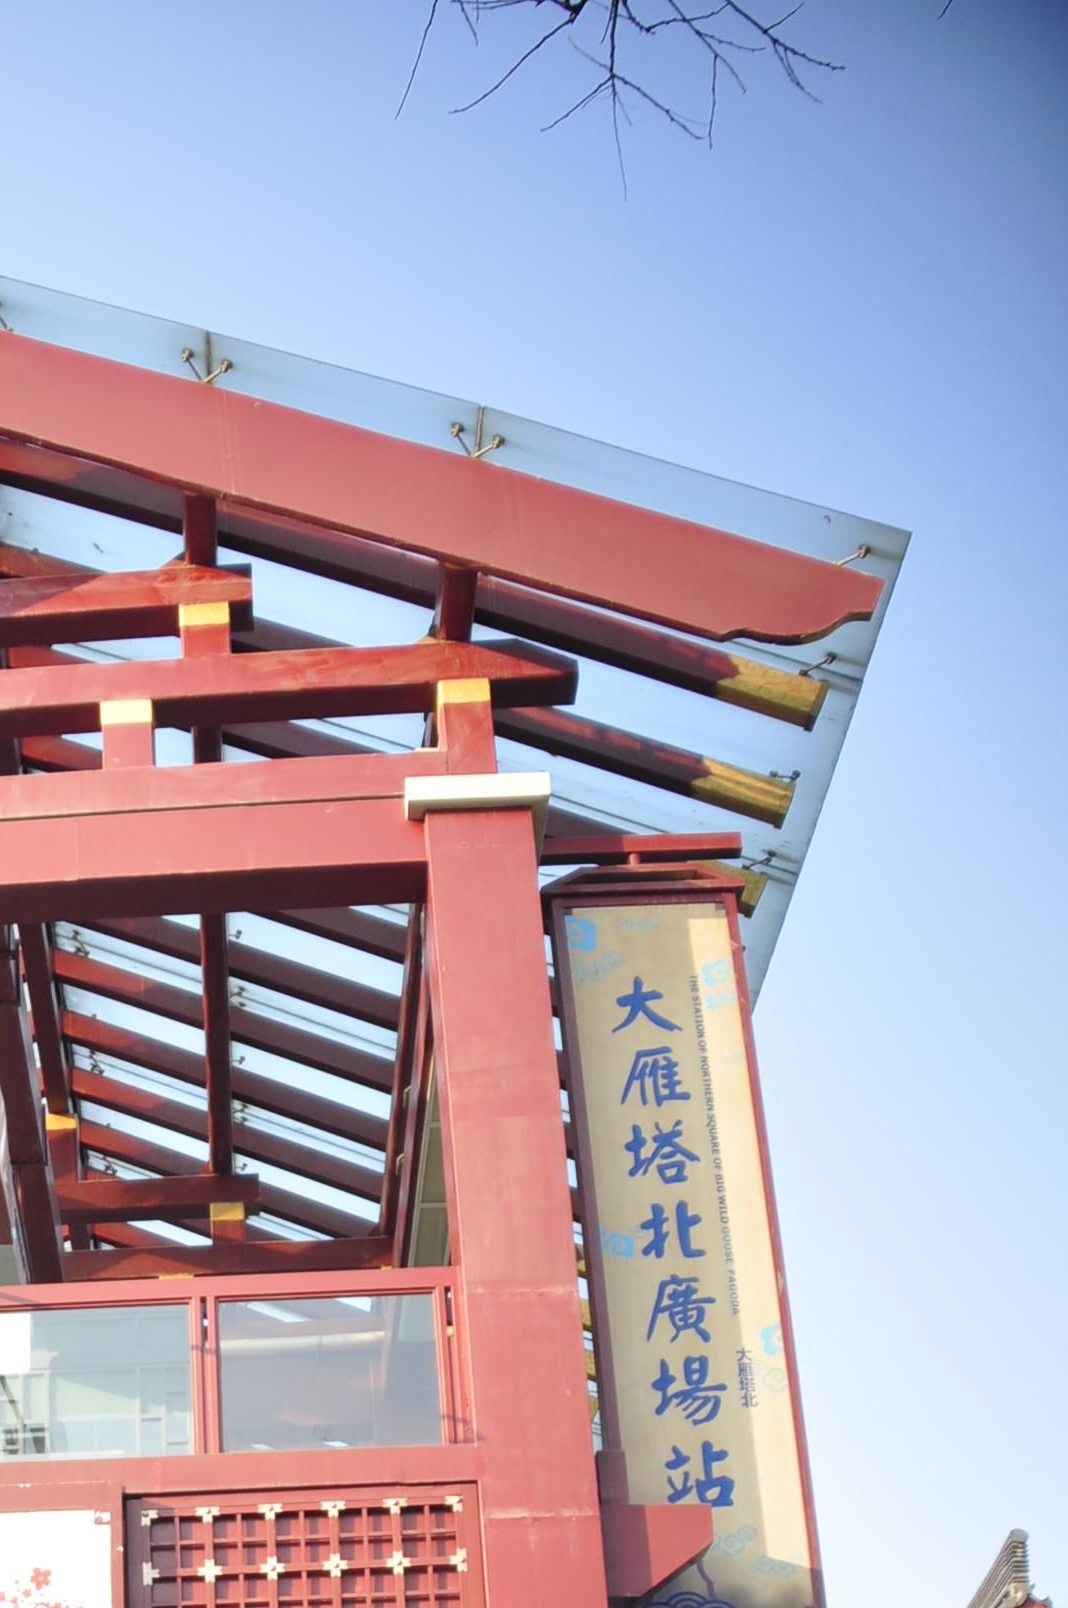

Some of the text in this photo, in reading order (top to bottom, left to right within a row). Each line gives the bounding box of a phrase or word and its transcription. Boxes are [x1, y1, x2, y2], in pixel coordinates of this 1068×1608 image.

[612, 976, 736, 1509] 大雁塔北廣場站
[689, 975, 740, 1315] THE STATION OF NORTHERN SQUARE OF BIG WILD GOOSE PAGODA
